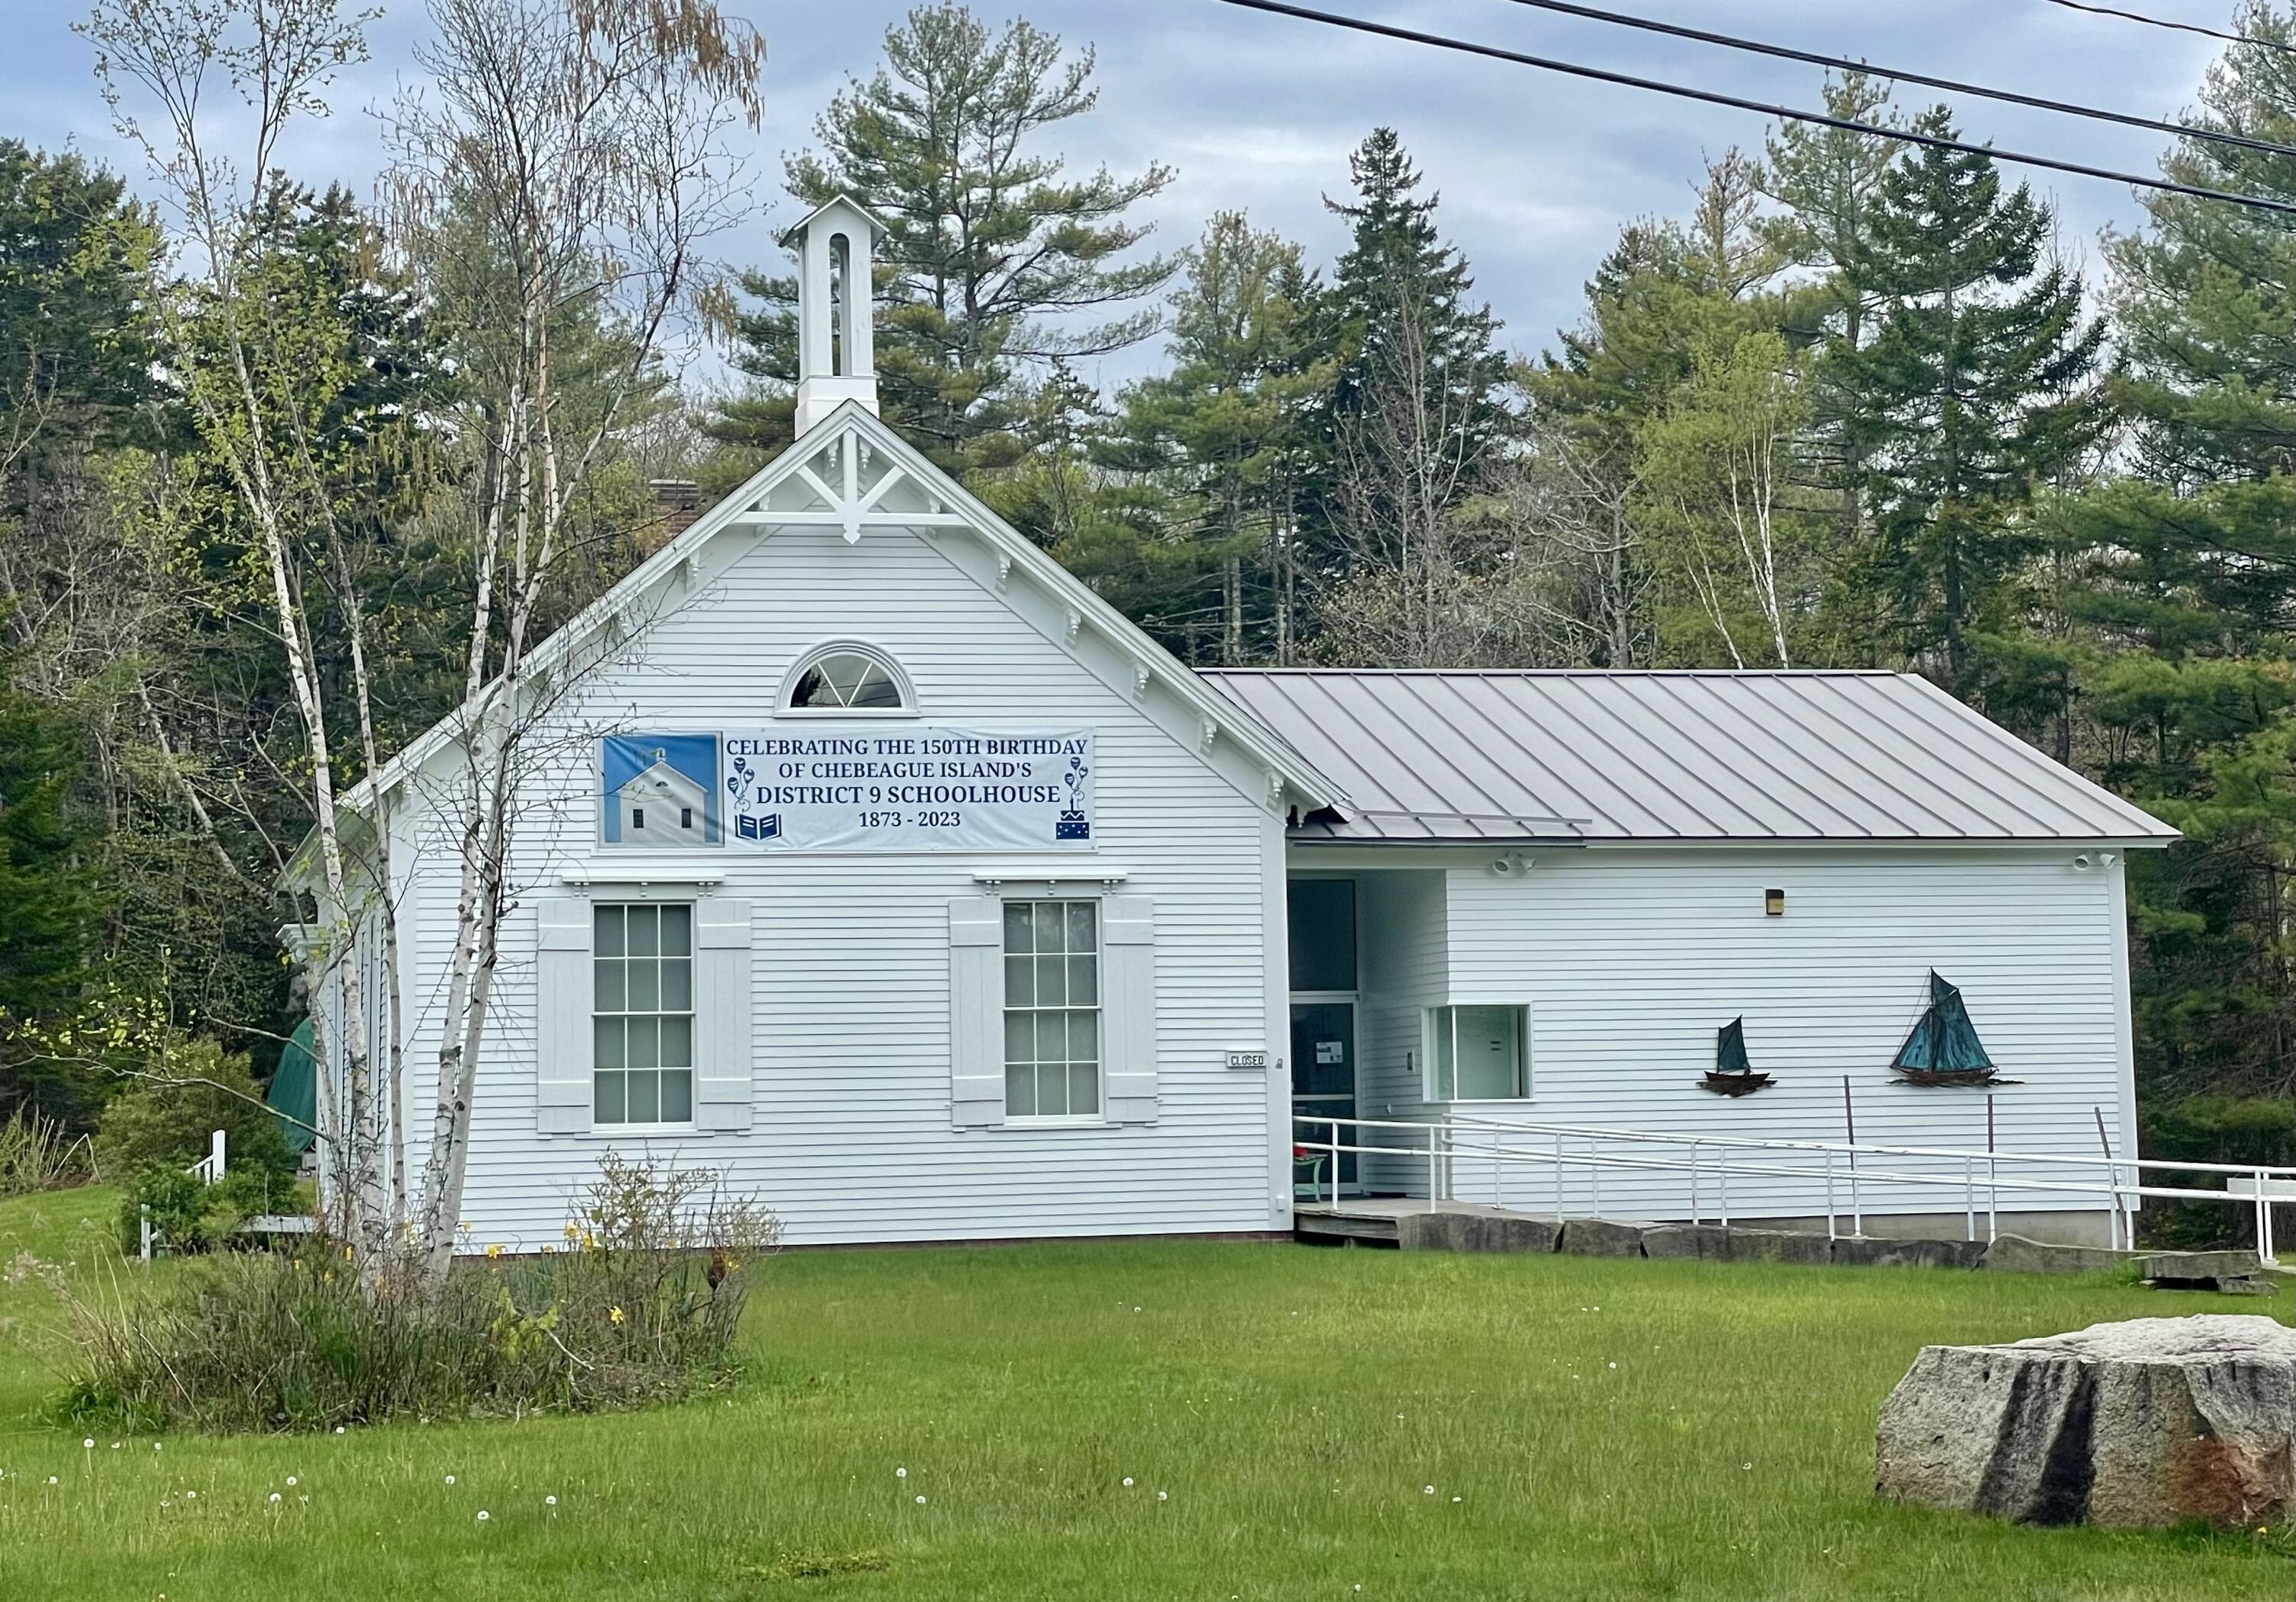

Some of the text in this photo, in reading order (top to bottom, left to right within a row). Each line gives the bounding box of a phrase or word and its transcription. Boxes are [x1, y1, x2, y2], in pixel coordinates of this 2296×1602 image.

[726, 739, 1088, 755] CELEBRATING THE 150TH BIRTHDAY
[779, 762, 1032, 778] OF CHEBEAGUE ISLAND'S
[756, 785, 1061, 804] DISTRICT 9 SCHOOLHOUSE
[859, 812, 902, 827] 1873
[918, 811, 960, 827] 2023
[1231, 1055, 1264, 1065] CLOSED
